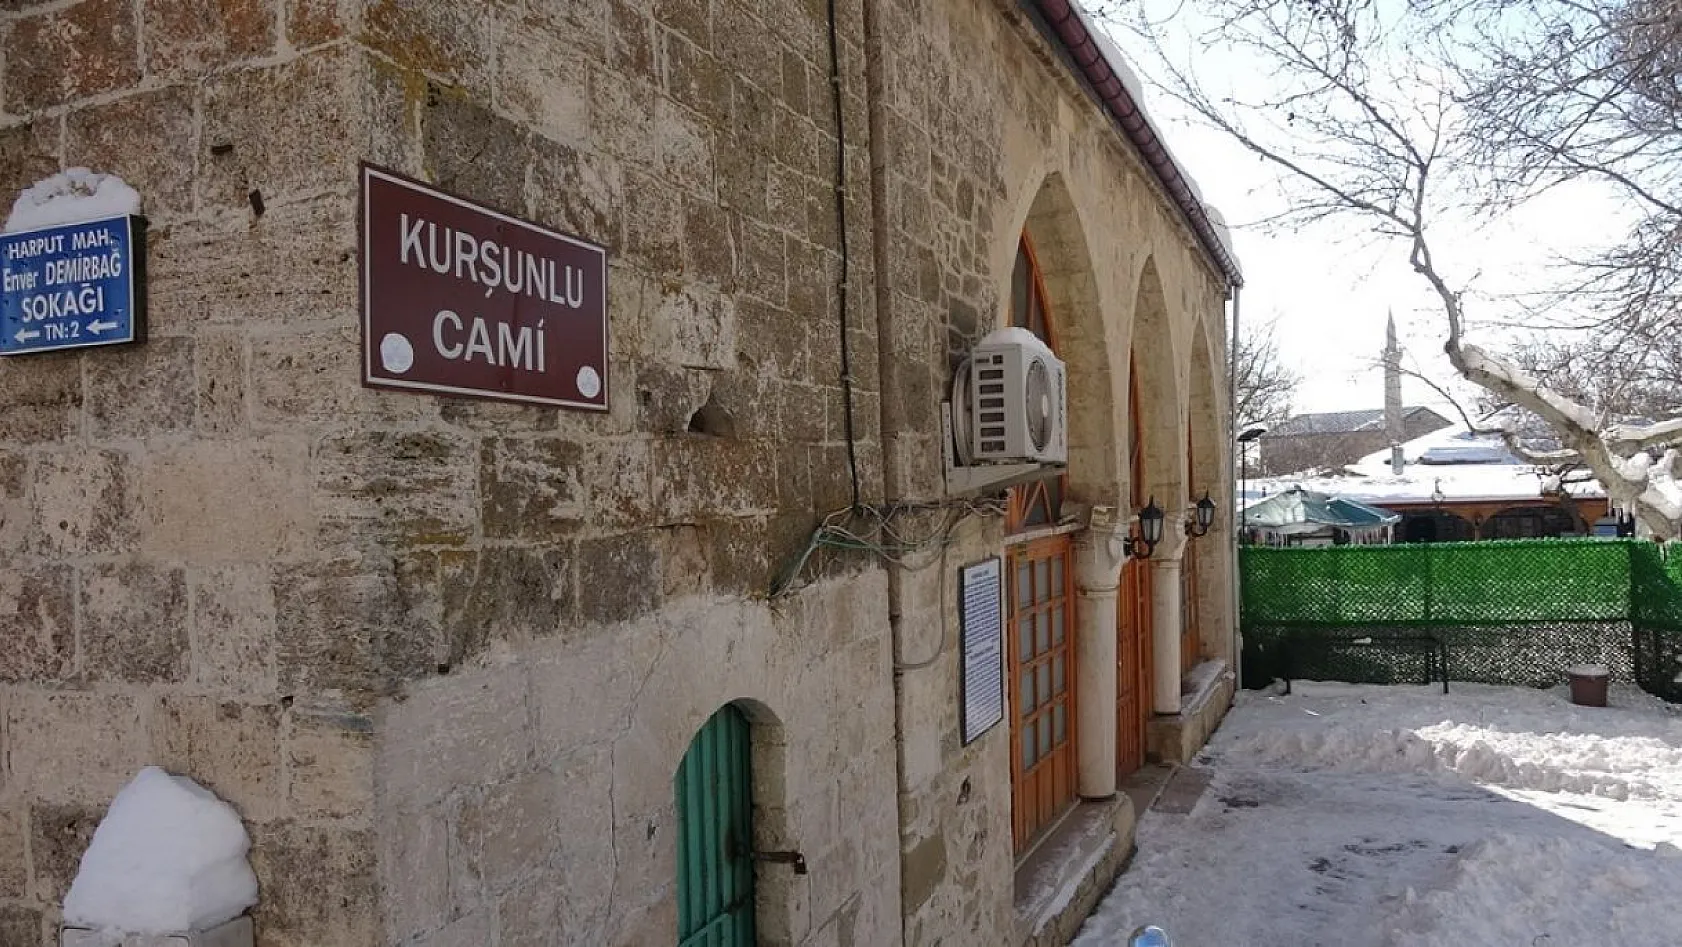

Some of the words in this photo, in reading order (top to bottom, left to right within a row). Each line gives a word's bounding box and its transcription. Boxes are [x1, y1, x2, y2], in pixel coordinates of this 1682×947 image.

[8, 235, 65, 260] HARPUT
[72, 228, 114, 251] MAH.
[401, 213, 584, 309] KURŞUNLU
[3, 268, 39, 293] Enver
[45, 248, 121, 286] DEMİRBAĞ
[21, 283, 104, 322] SOKAĞI
[43, 321, 80, 341] TN:2
